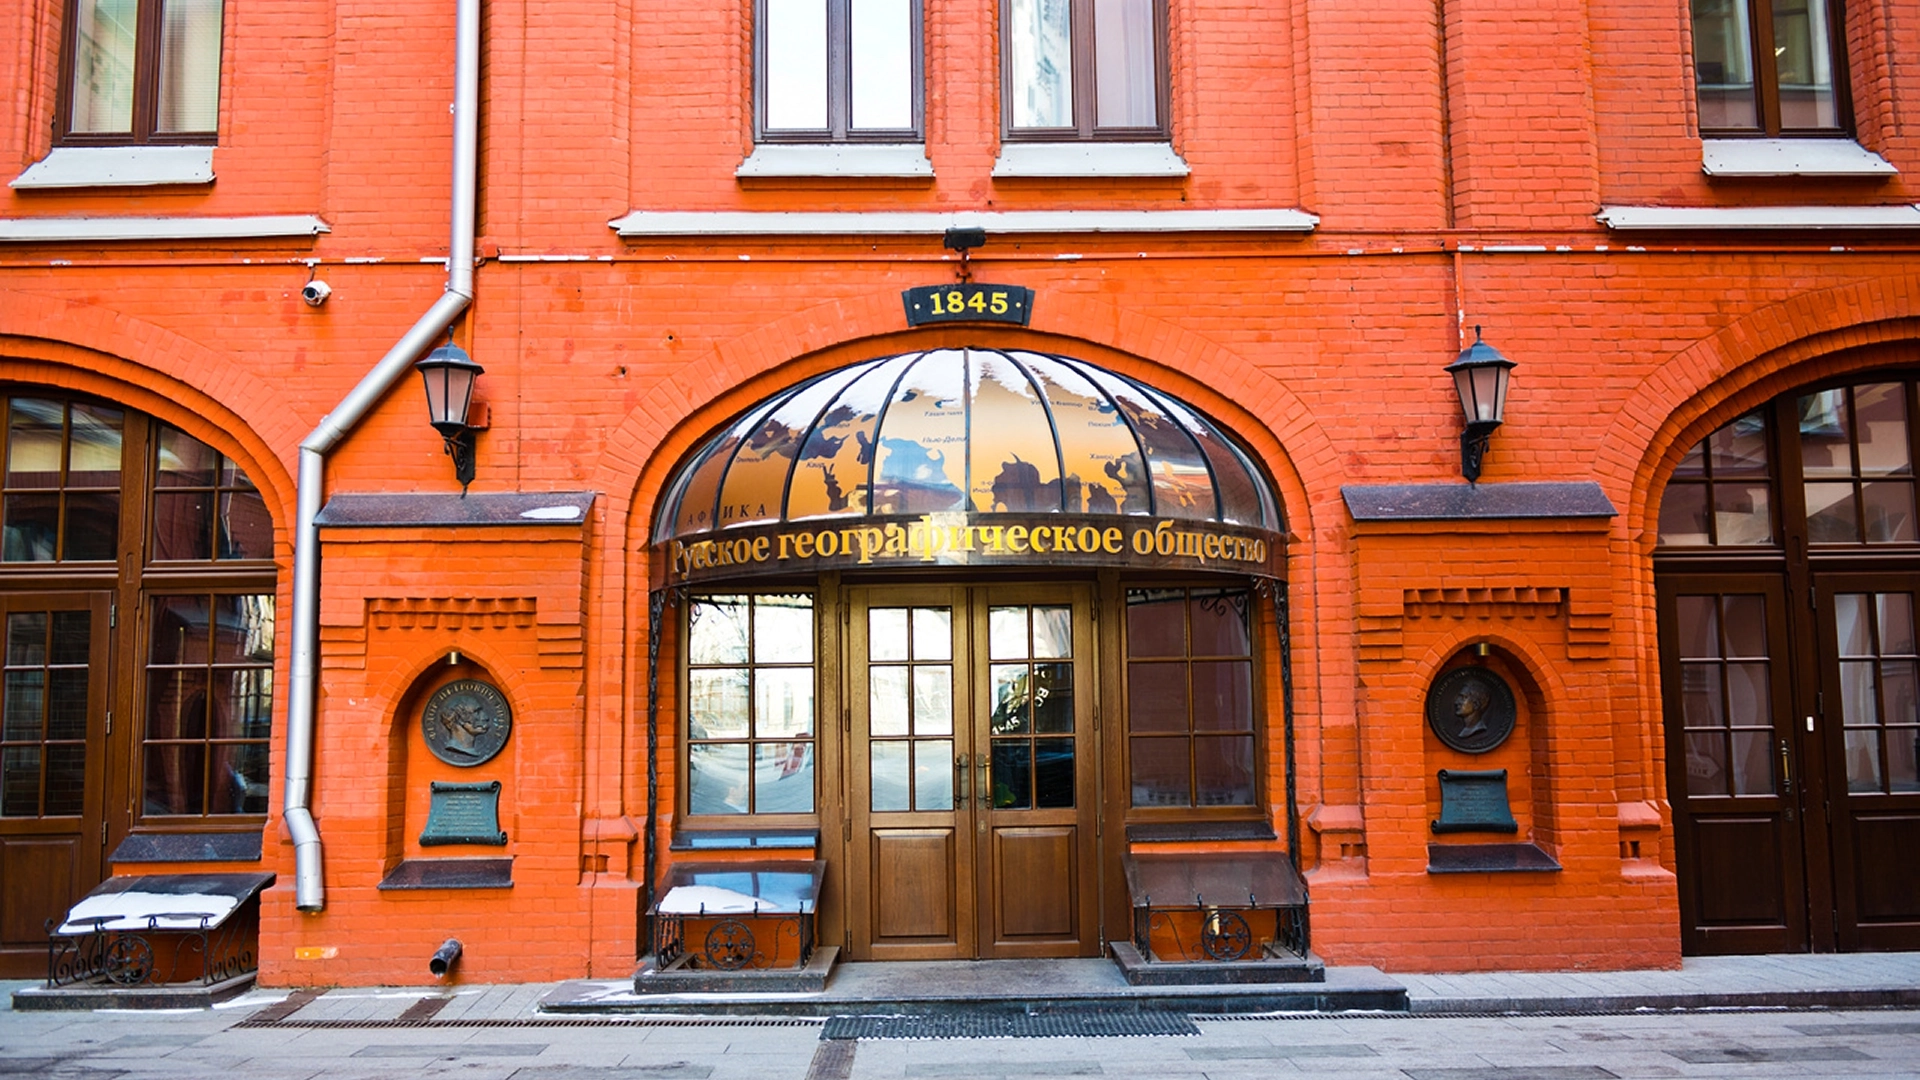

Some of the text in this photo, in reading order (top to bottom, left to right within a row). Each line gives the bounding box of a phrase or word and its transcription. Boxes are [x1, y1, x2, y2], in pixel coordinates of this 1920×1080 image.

[930, 291, 1008, 315] 1845
[670, 515, 1268, 579] Русское географическое общество
